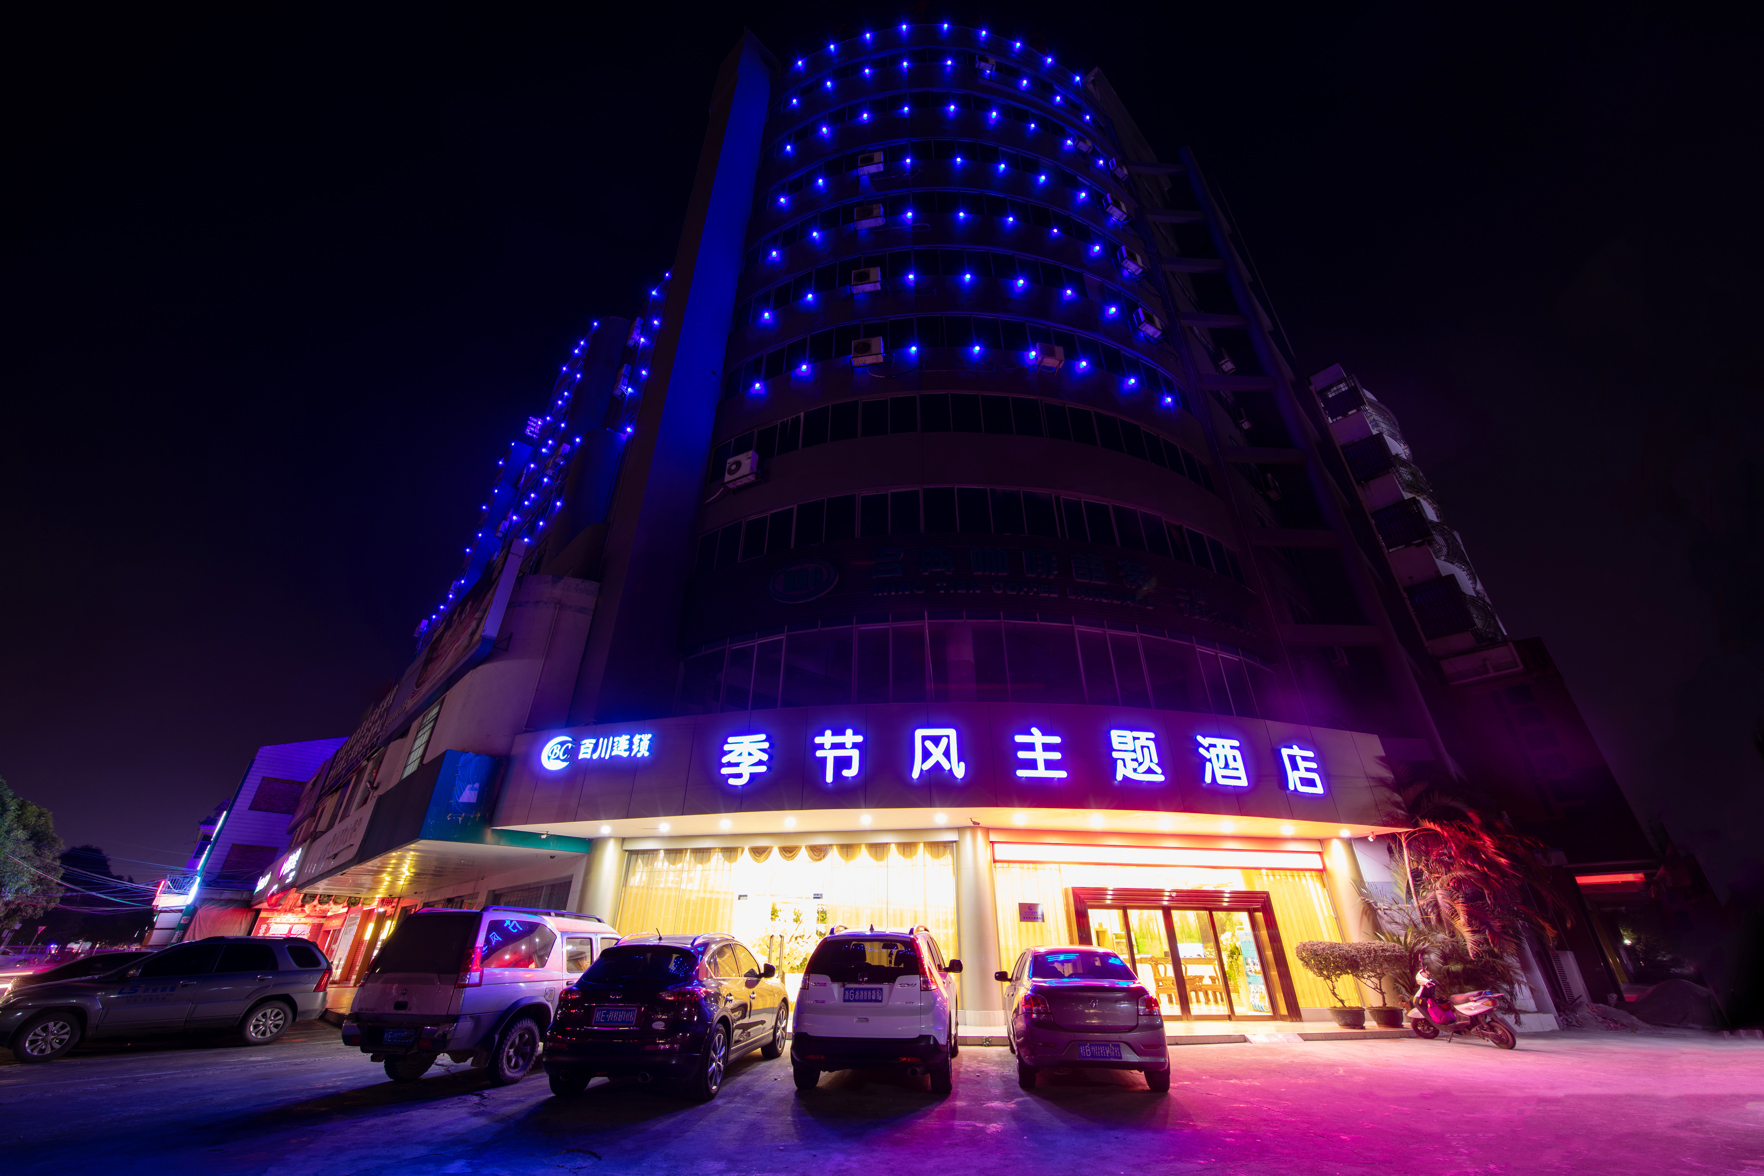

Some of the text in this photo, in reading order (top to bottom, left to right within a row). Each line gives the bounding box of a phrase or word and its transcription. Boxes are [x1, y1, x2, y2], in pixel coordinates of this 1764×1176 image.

[872, 581, 1155, 610] MING TIEN COFFEE LANGUAGE
[721, 728, 1323, 794] 季节风主题酒店
